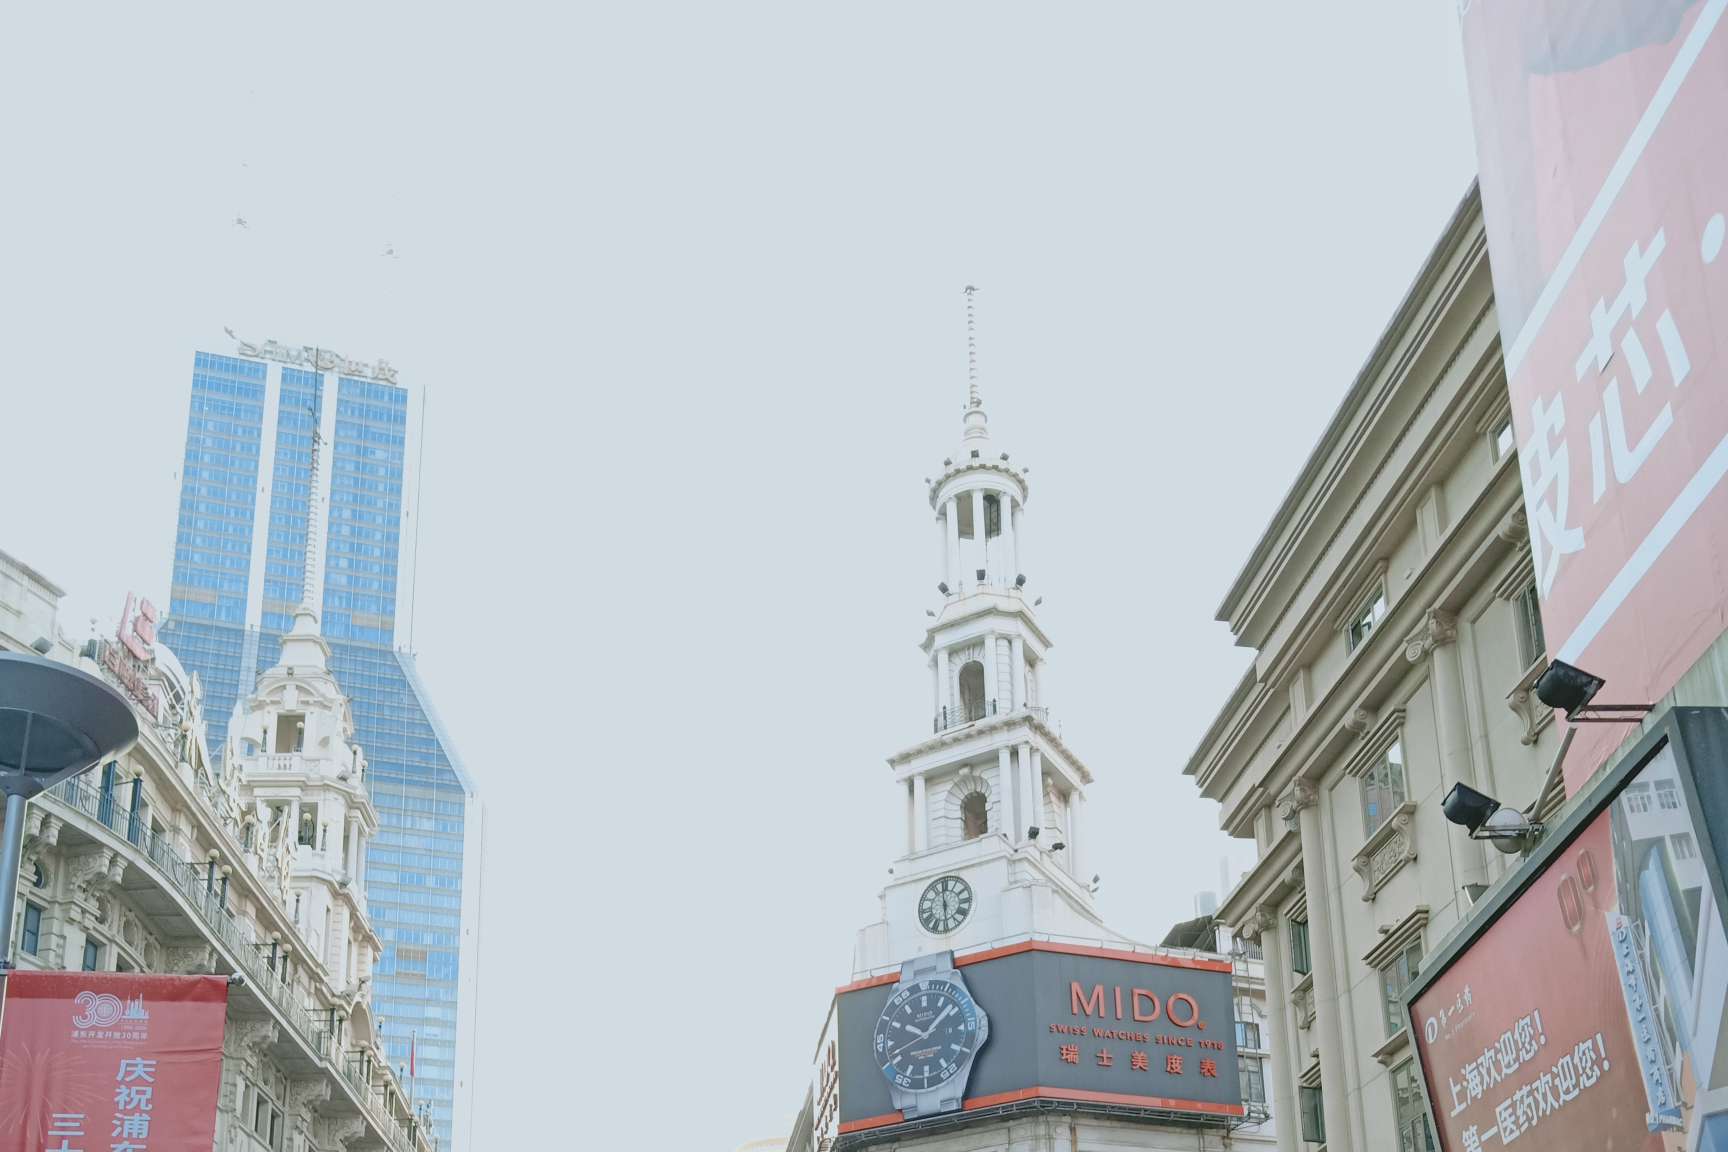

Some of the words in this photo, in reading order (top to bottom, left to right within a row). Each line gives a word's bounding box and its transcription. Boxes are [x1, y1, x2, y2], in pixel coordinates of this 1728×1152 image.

[1070, 980, 1200, 1029] MIDO
[1049, 1023, 1089, 1038] SWISS
[1092, 1028, 1150, 1044] WATCHES
[1155, 1033, 1194, 1049] SINCE
[1059, 1043, 1218, 1079] 瑞士美度表
